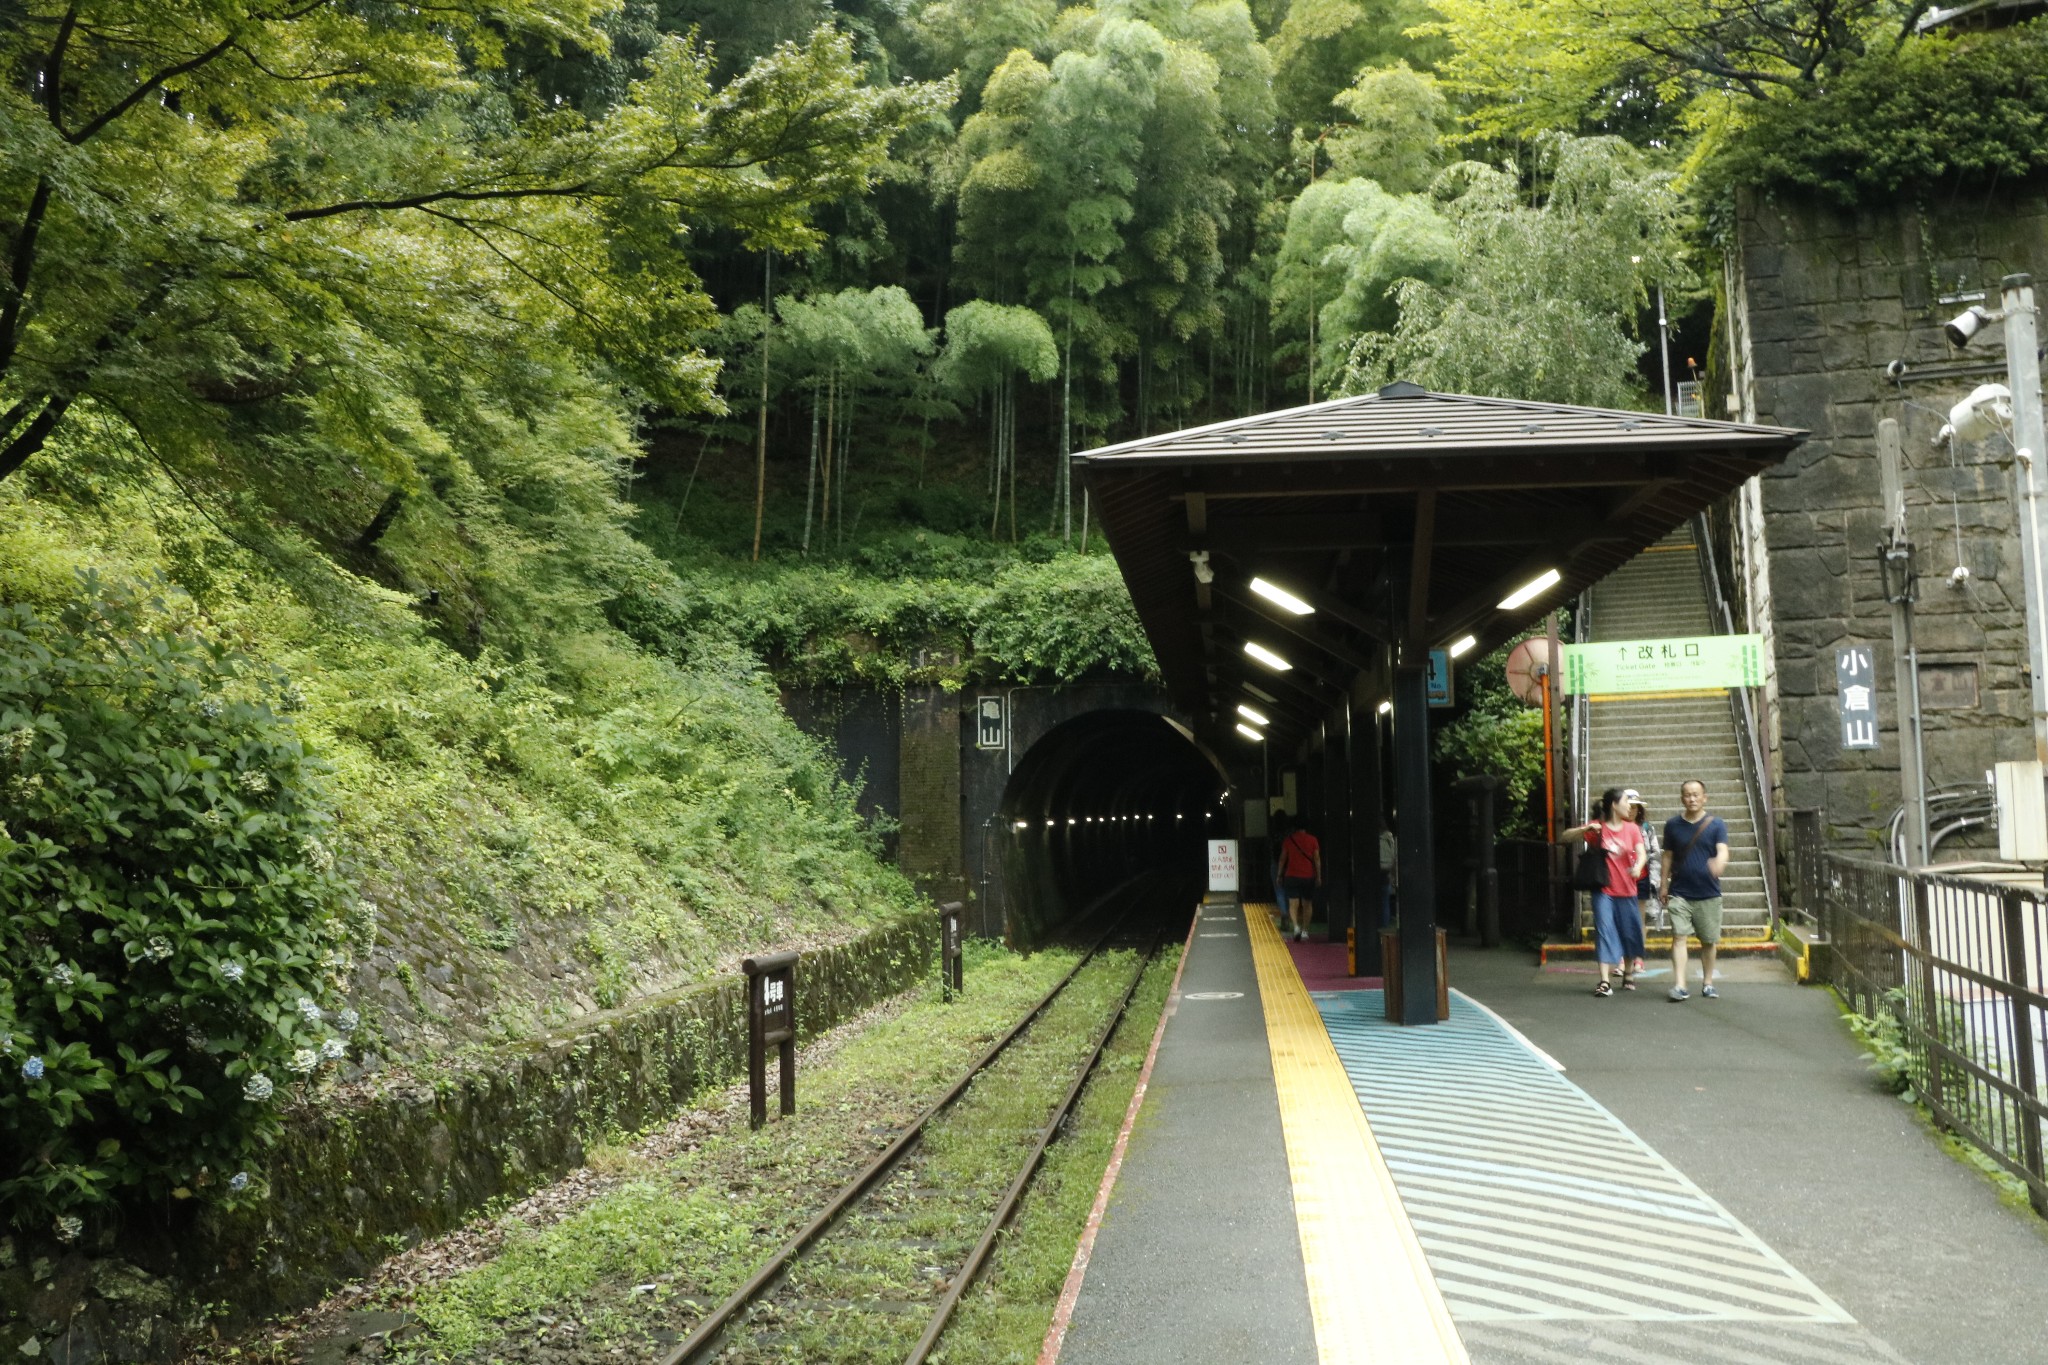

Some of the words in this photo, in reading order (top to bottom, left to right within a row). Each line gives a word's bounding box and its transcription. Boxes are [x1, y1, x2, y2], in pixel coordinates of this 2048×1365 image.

[1638, 643, 1699, 659] 改札口
[1616, 663, 1637, 671] Ticket
[1841, 649, 1874, 746] 小倉山
